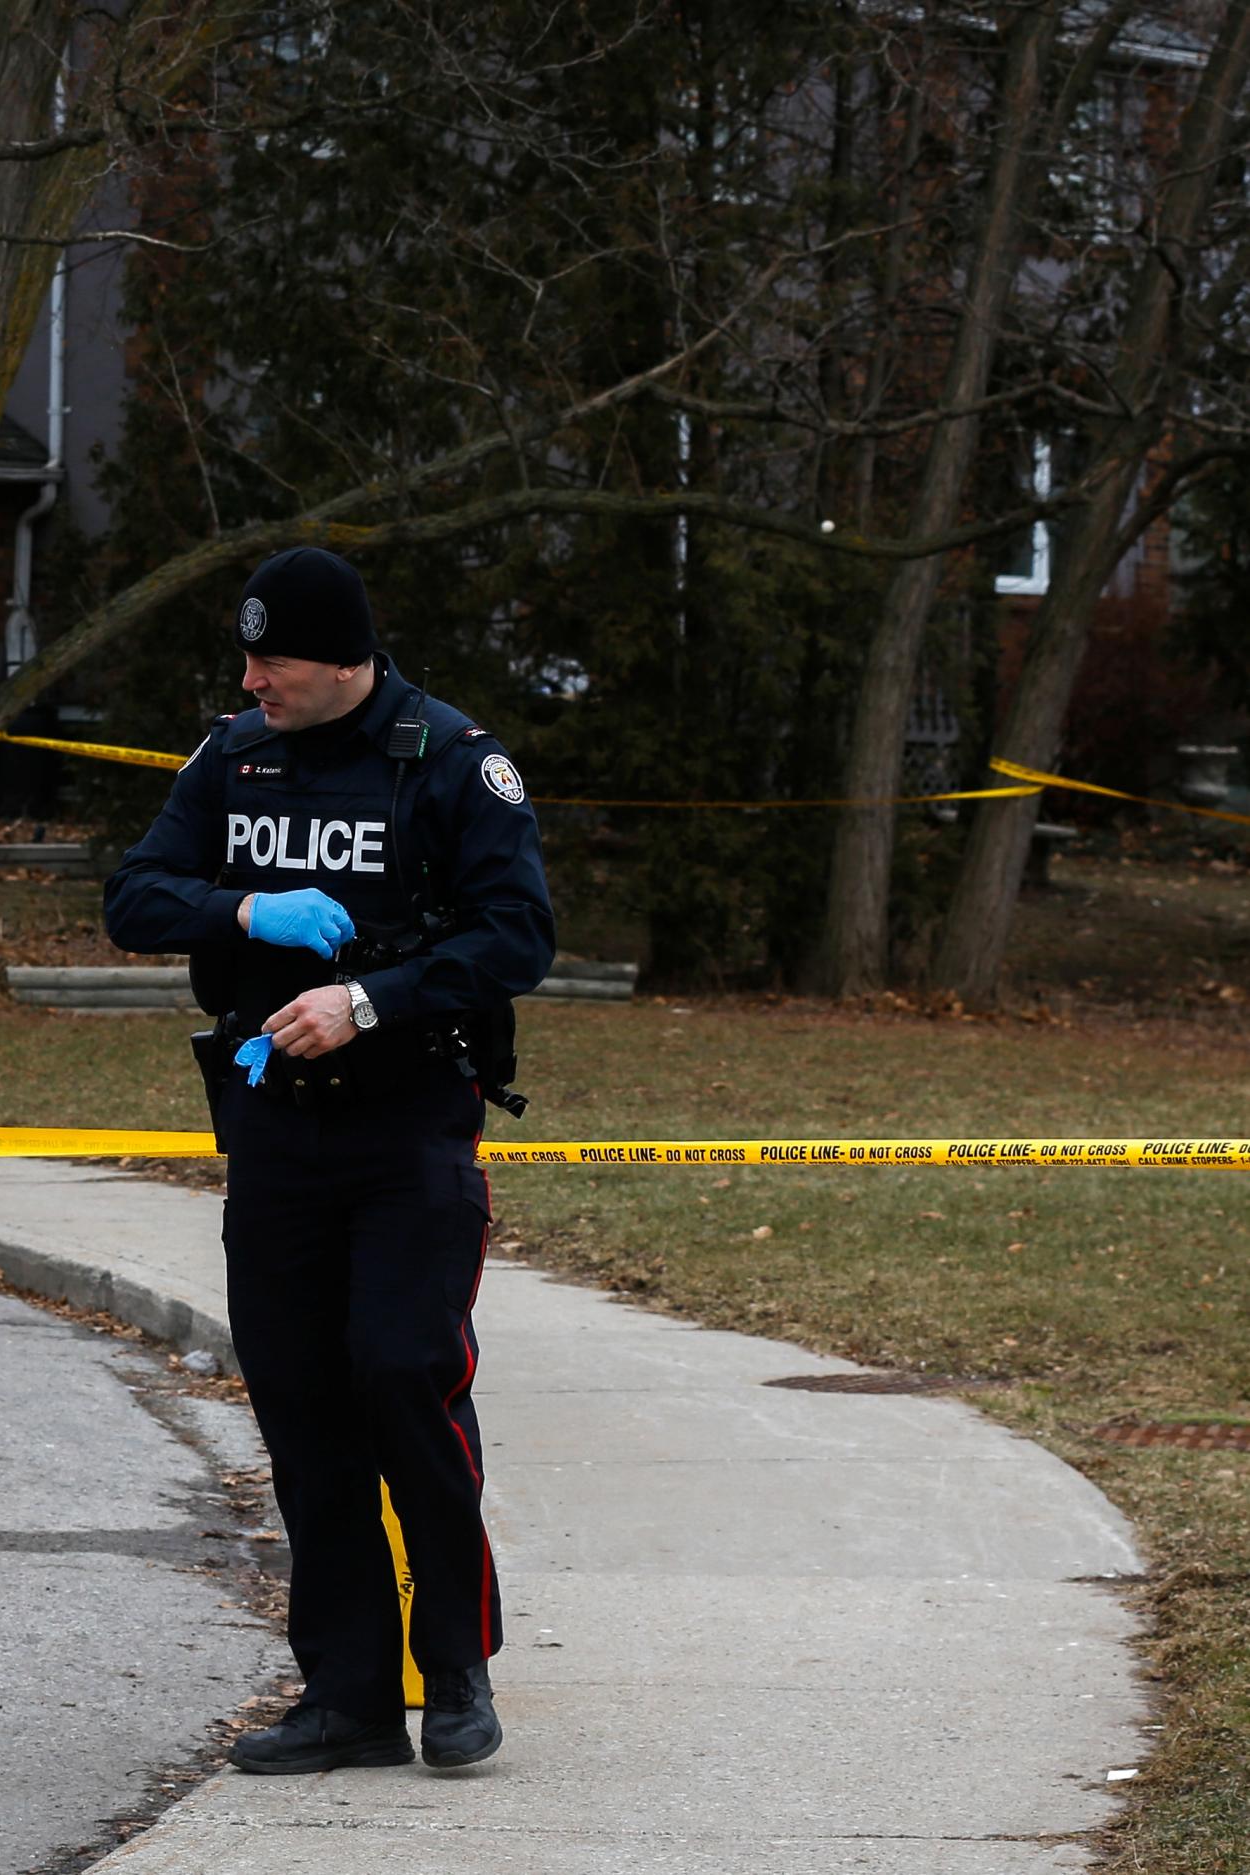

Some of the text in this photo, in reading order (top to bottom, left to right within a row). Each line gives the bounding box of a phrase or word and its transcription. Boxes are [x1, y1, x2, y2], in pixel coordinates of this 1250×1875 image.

[227, 814, 386, 872] POLICE
[580, 1147, 745, 1162] POLICE LINE- DO NOT CROSS
[760, 1145, 933, 1161] POLICE LINE- DO NOT CROSS
[948, 1143, 1128, 1158] POLICE LINE- DO NOT CROSS
[1143, 1142, 1195, 1155] POLICE
[1197, 1142, 1235, 1154] LINE-
[490, 1152, 505, 1161] DO
[508, 1152, 528, 1162] NOT
[532, 1152, 567, 1162] CROSS
[1138, 1157, 1158, 1165] CALL
[1161, 1157, 1188, 1165] CRIME
